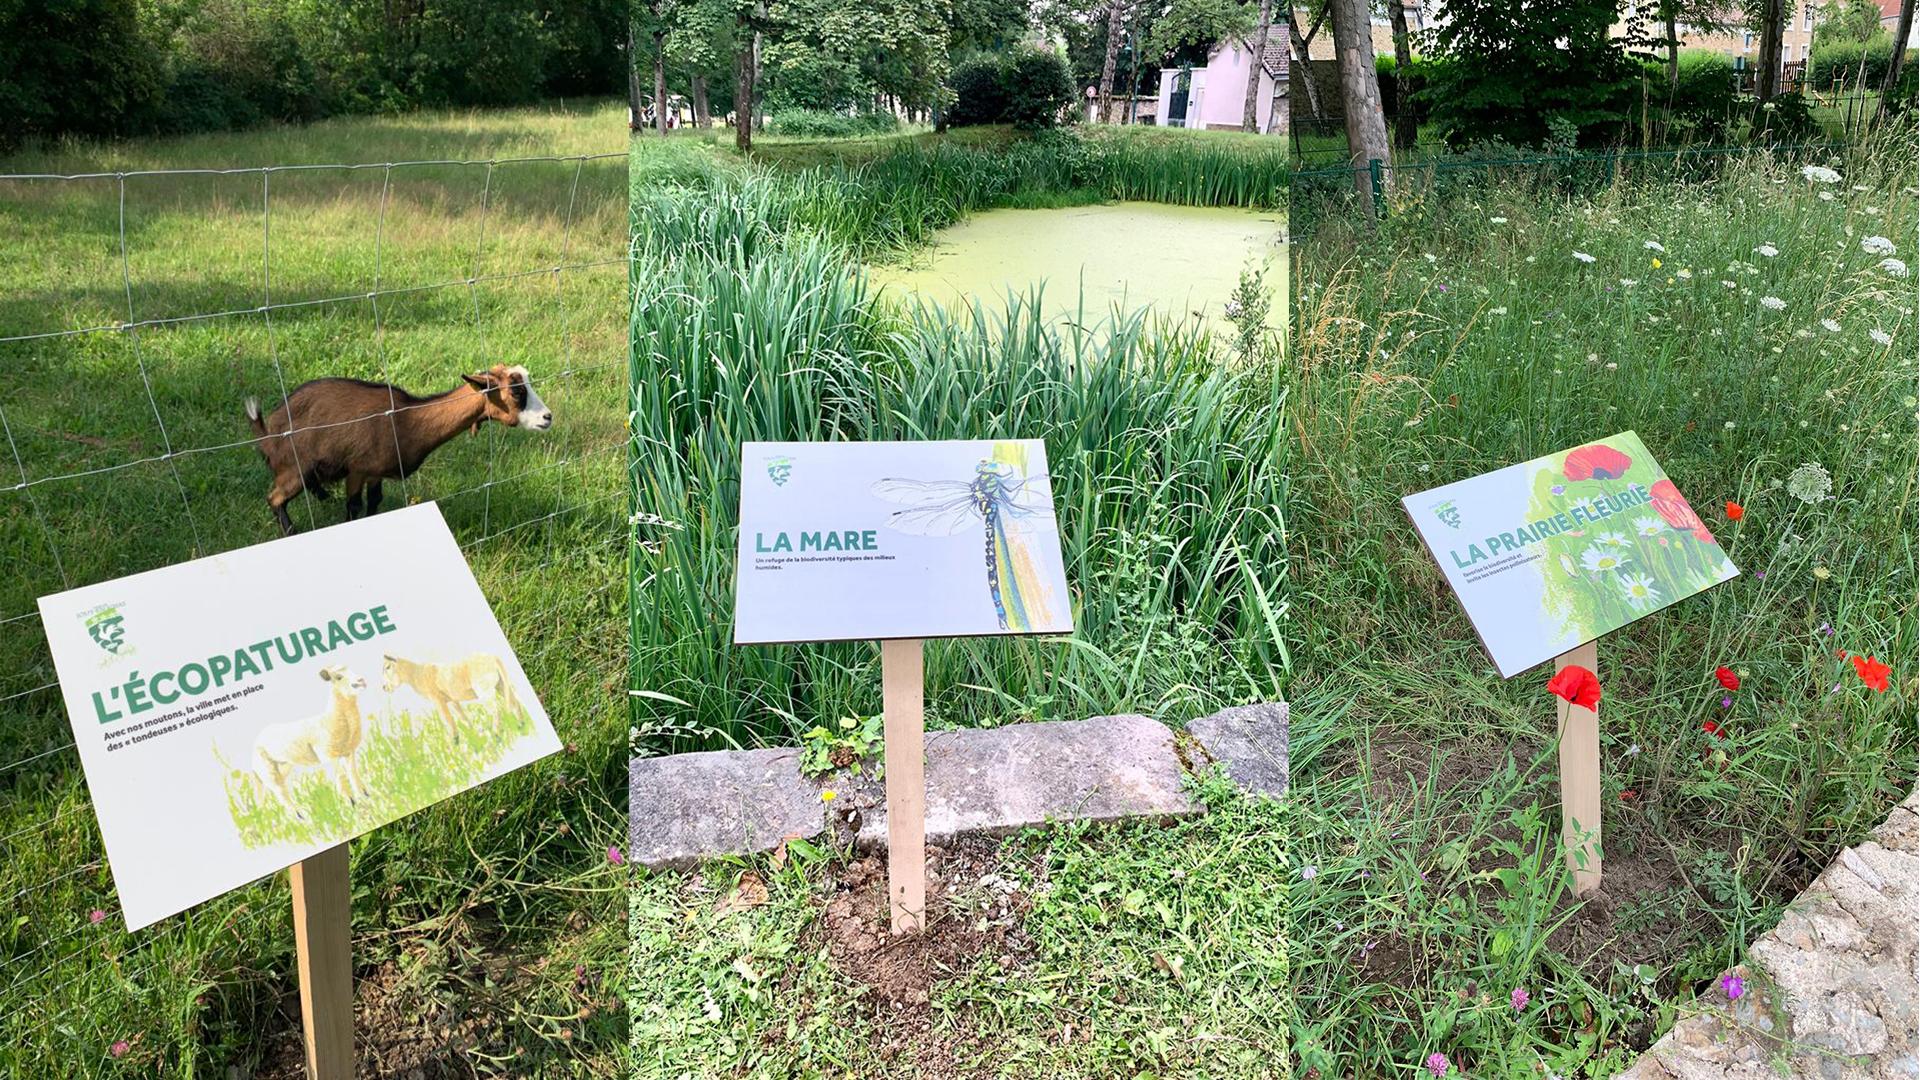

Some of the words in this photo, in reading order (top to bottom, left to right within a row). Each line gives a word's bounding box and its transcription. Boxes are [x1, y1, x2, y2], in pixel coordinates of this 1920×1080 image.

[756, 532, 793, 553] LA
[800, 530, 878, 552] MARE
[1450, 543, 1488, 569] LA
[1485, 512, 1574, 556] PRAIRIE
[1570, 485, 1653, 526] FLEURIE
[837, 555, 862, 563] typiques
[91, 604, 397, 725] L'ÉCOPATURAGE
[104, 729, 126, 741] Avec
[127, 723, 143, 733] nos
[144, 710, 186, 727] moutons,
[186, 706, 195, 714] la
[195, 700, 213, 711] ville
[213, 694, 231, 705] met
[232, 690, 243, 699] en
[243, 683, 264, 697] place
[106, 741, 123, 752] des
[132, 724, 177, 744] tondeuses
[185, 705, 239, 726] écologiques.
